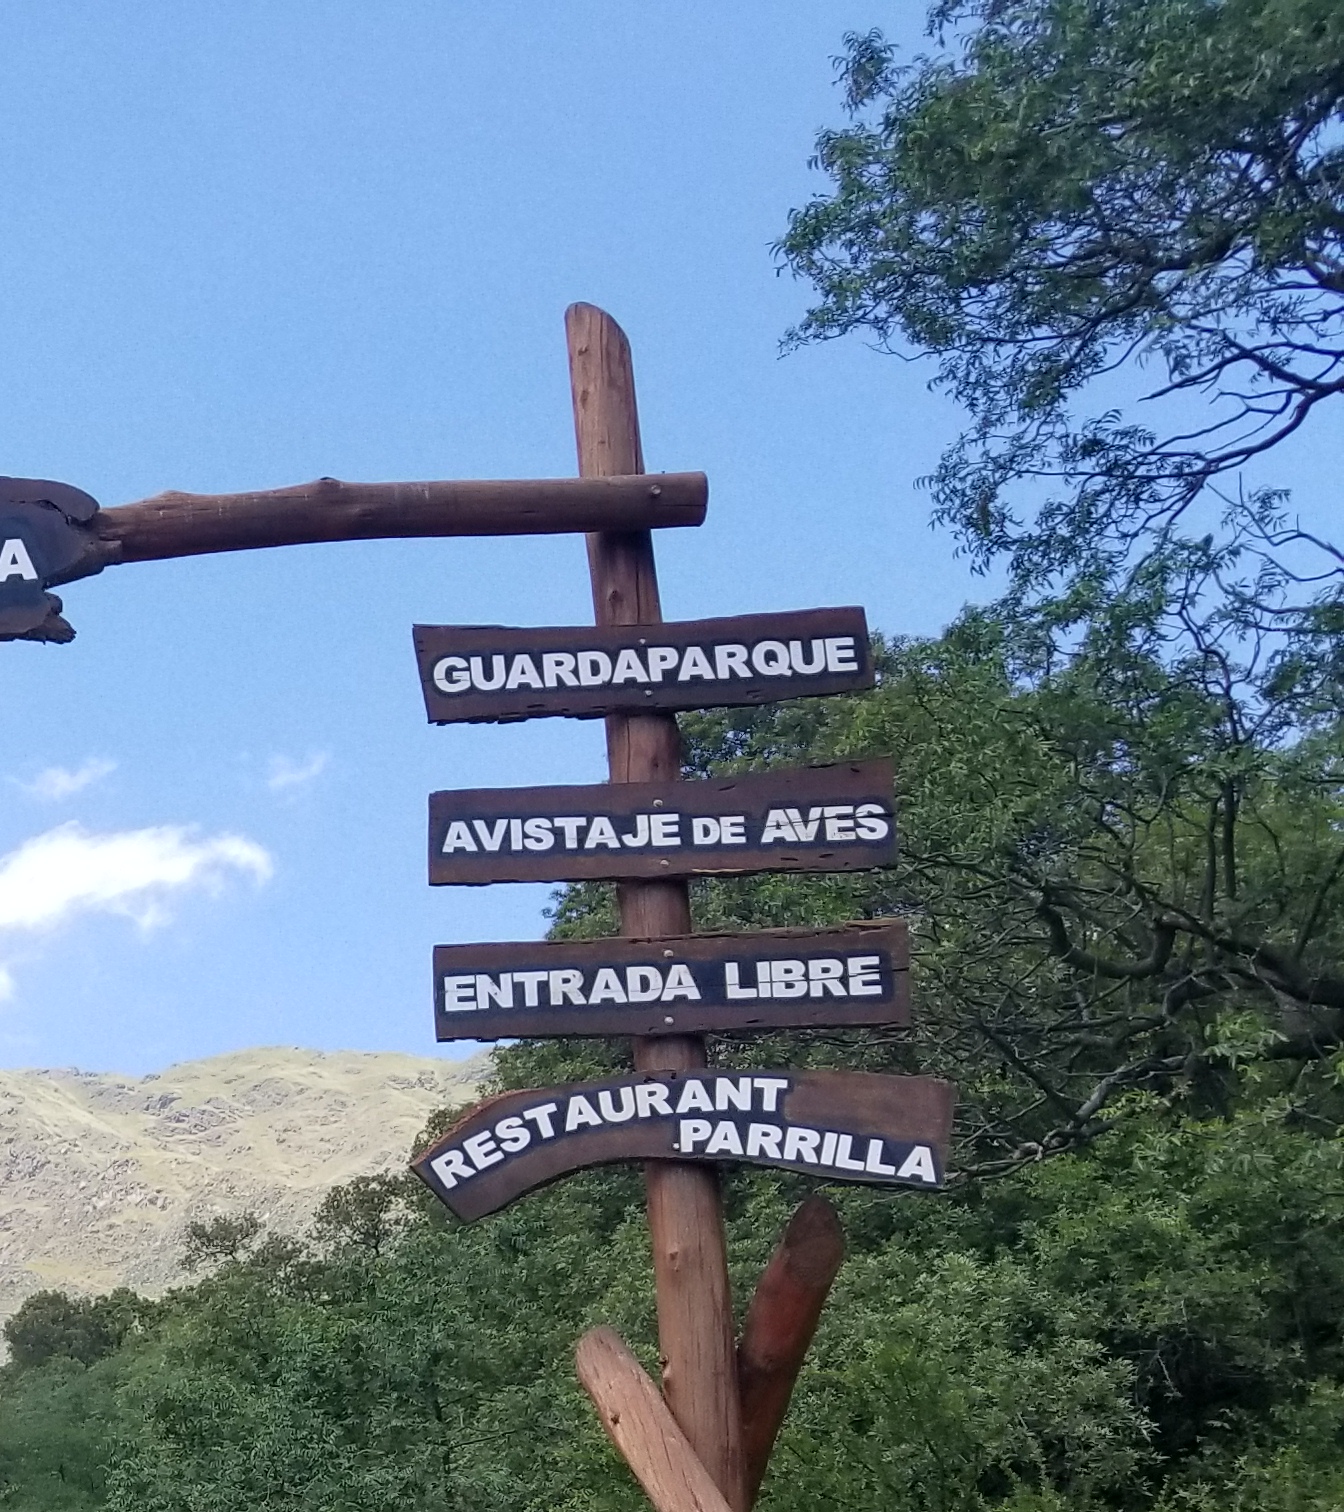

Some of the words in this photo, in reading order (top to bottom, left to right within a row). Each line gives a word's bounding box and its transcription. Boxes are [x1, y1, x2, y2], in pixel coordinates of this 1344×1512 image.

[433, 636, 858, 693] GUARDAPARQUE
[442, 813, 681, 853] AVISTAJE
[692, 815, 747, 845] DE
[760, 804, 889, 843] AVES
[443, 964, 701, 1012] ENTRADA
[725, 955, 883, 999] LIBRE
[429, 1077, 789, 1190] RESTAURANT
[679, 1118, 937, 1183] PARRILLA
